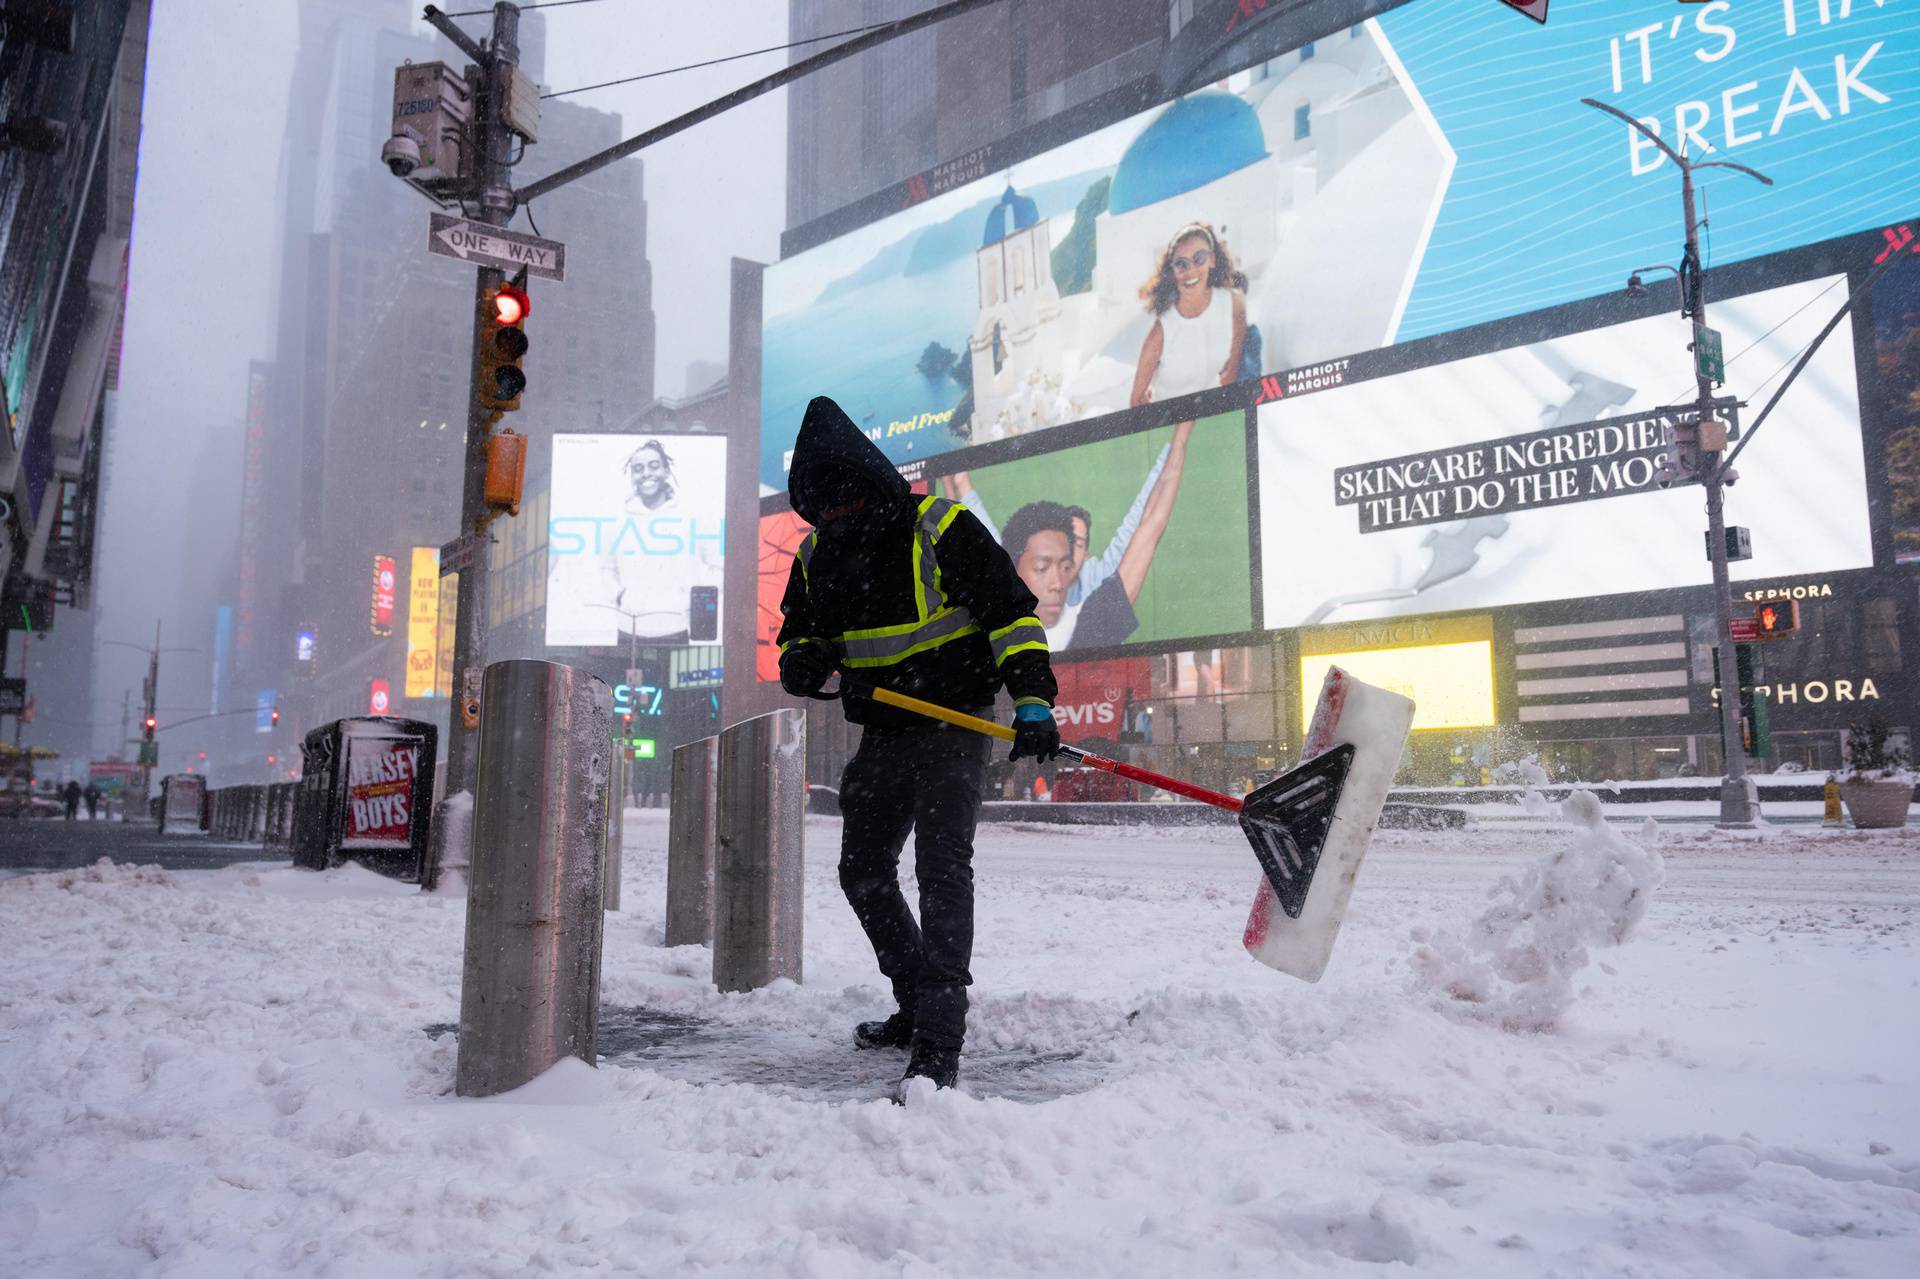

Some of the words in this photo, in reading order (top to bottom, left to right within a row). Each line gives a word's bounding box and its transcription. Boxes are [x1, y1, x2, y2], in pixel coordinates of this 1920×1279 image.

[1610, 1, 1736, 93] IT'S
[1627, 41, 1892, 177] BREAK
[451, 230, 489, 252] ONE
[508, 243, 549, 265] WAY
[1288, 360, 1350, 383] MARRIOTT
[1288, 373, 1343, 394] MARQUIS
[886, 415, 917, 437] Feel
[917, 408, 953, 427] Free
[1339, 450, 1485, 501] SKINCARE
[1365, 488, 1446, 527] THAT
[1453, 480, 1506, 514] DO
[1510, 468, 1579, 504] THE
[1588, 452, 1669, 494] MOS
[548, 515, 728, 558] STASH
[1744, 584, 1832, 602] SEPHORA
[350, 748, 418, 786] JERSEY
[352, 793, 409, 833] BOYS
